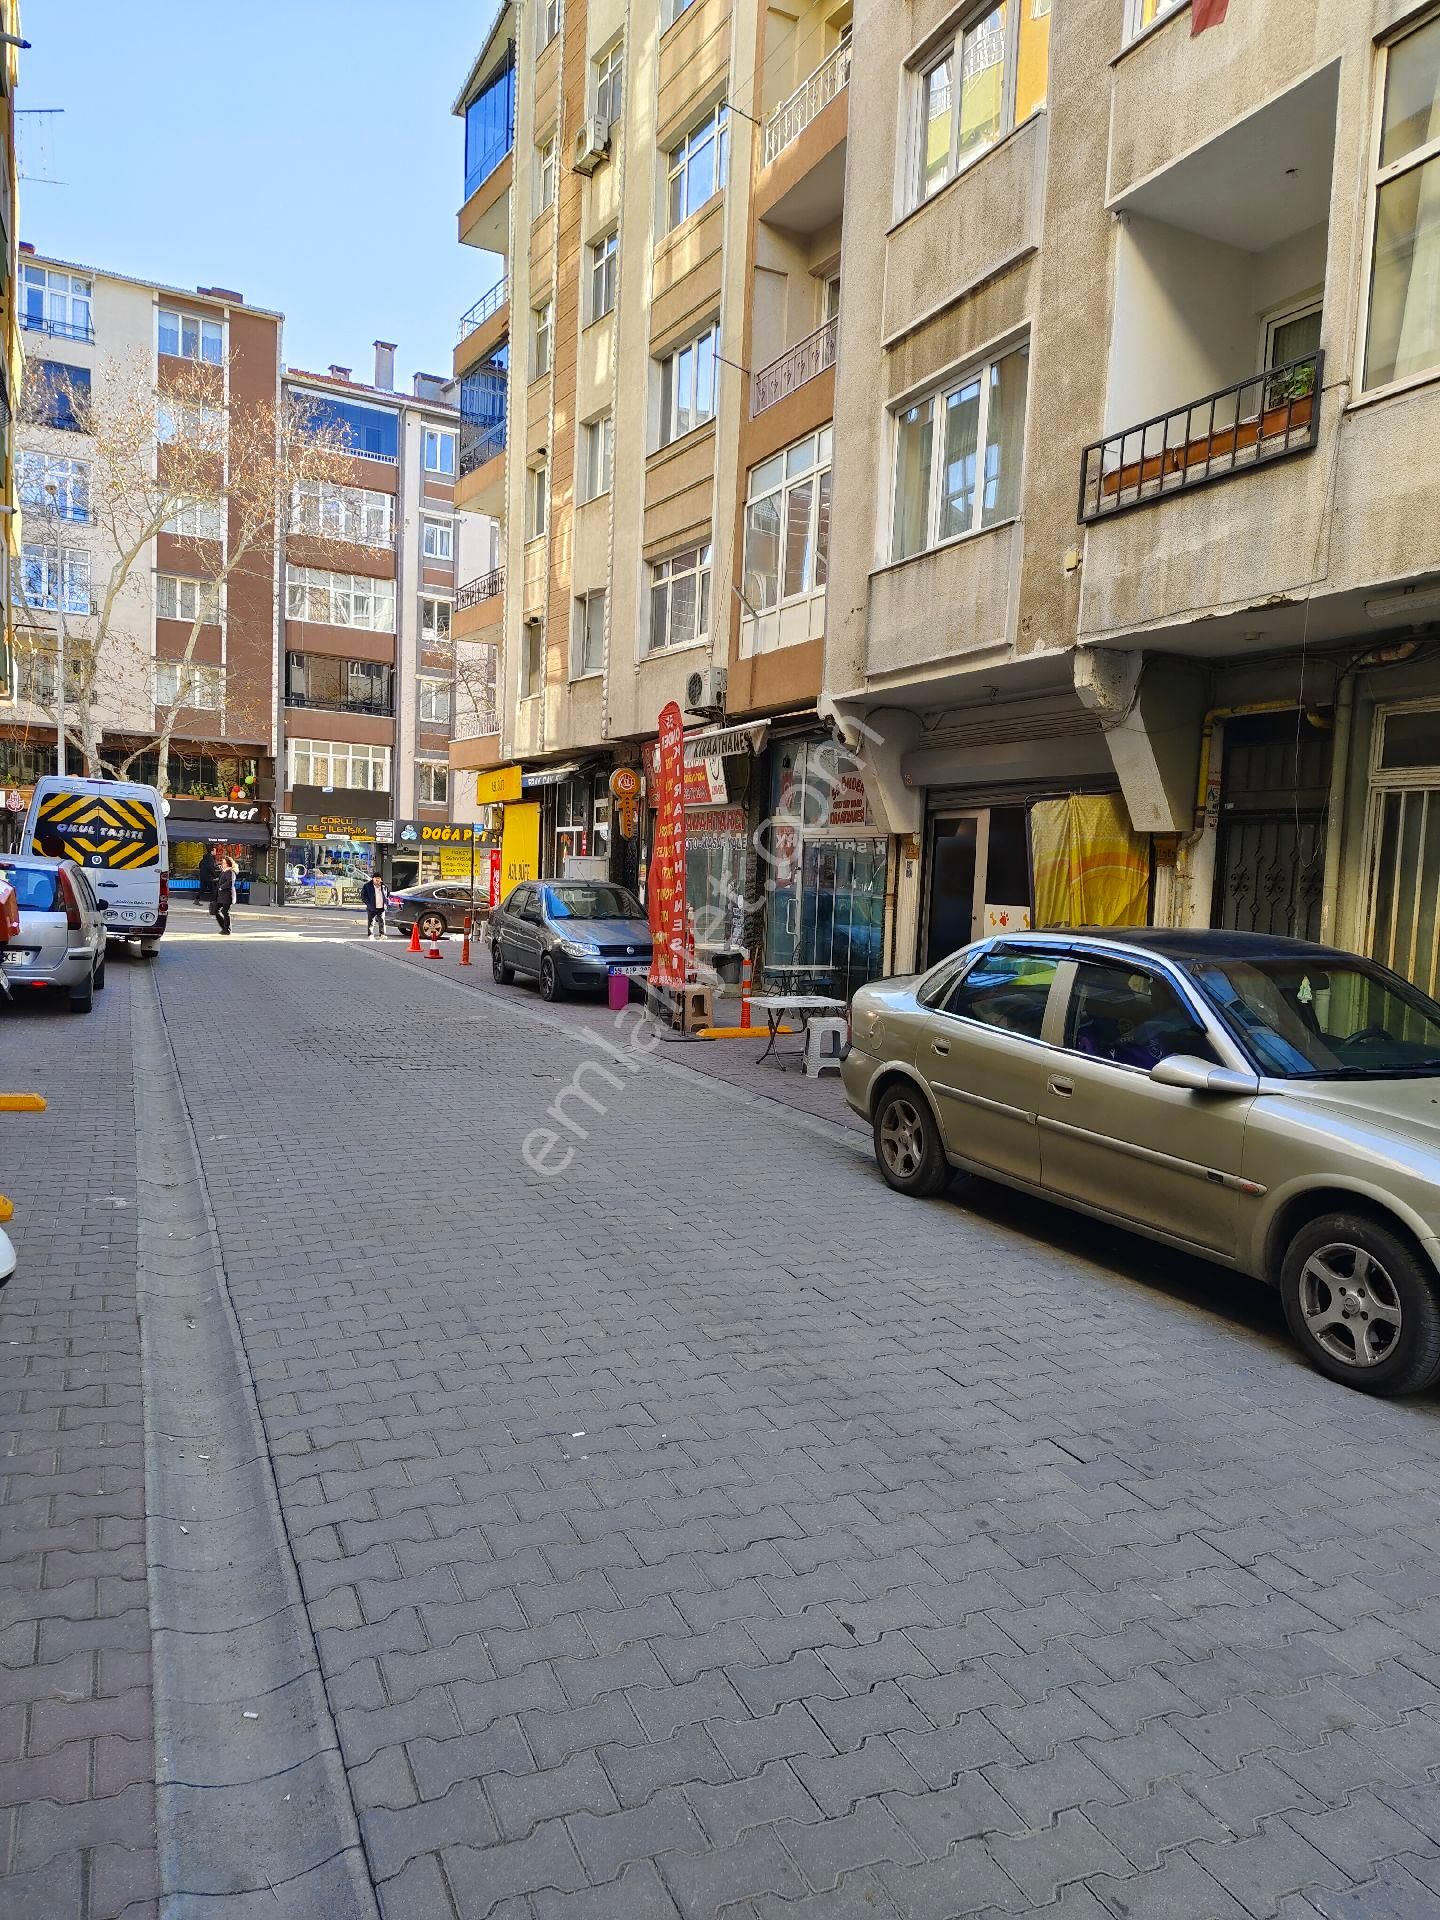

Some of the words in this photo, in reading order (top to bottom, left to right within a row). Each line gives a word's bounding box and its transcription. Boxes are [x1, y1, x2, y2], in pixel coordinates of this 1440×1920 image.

[694, 729, 752, 758] KIRAATHANES
[212, 804, 259, 820] Chef
[56, 823, 95, 835] OKUL
[99, 827, 144, 841] TAŞITI
[306, 824, 327, 833] CEP
[328, 824, 367, 835] İLETİŞİM
[421, 825, 460, 841] DOĞA
